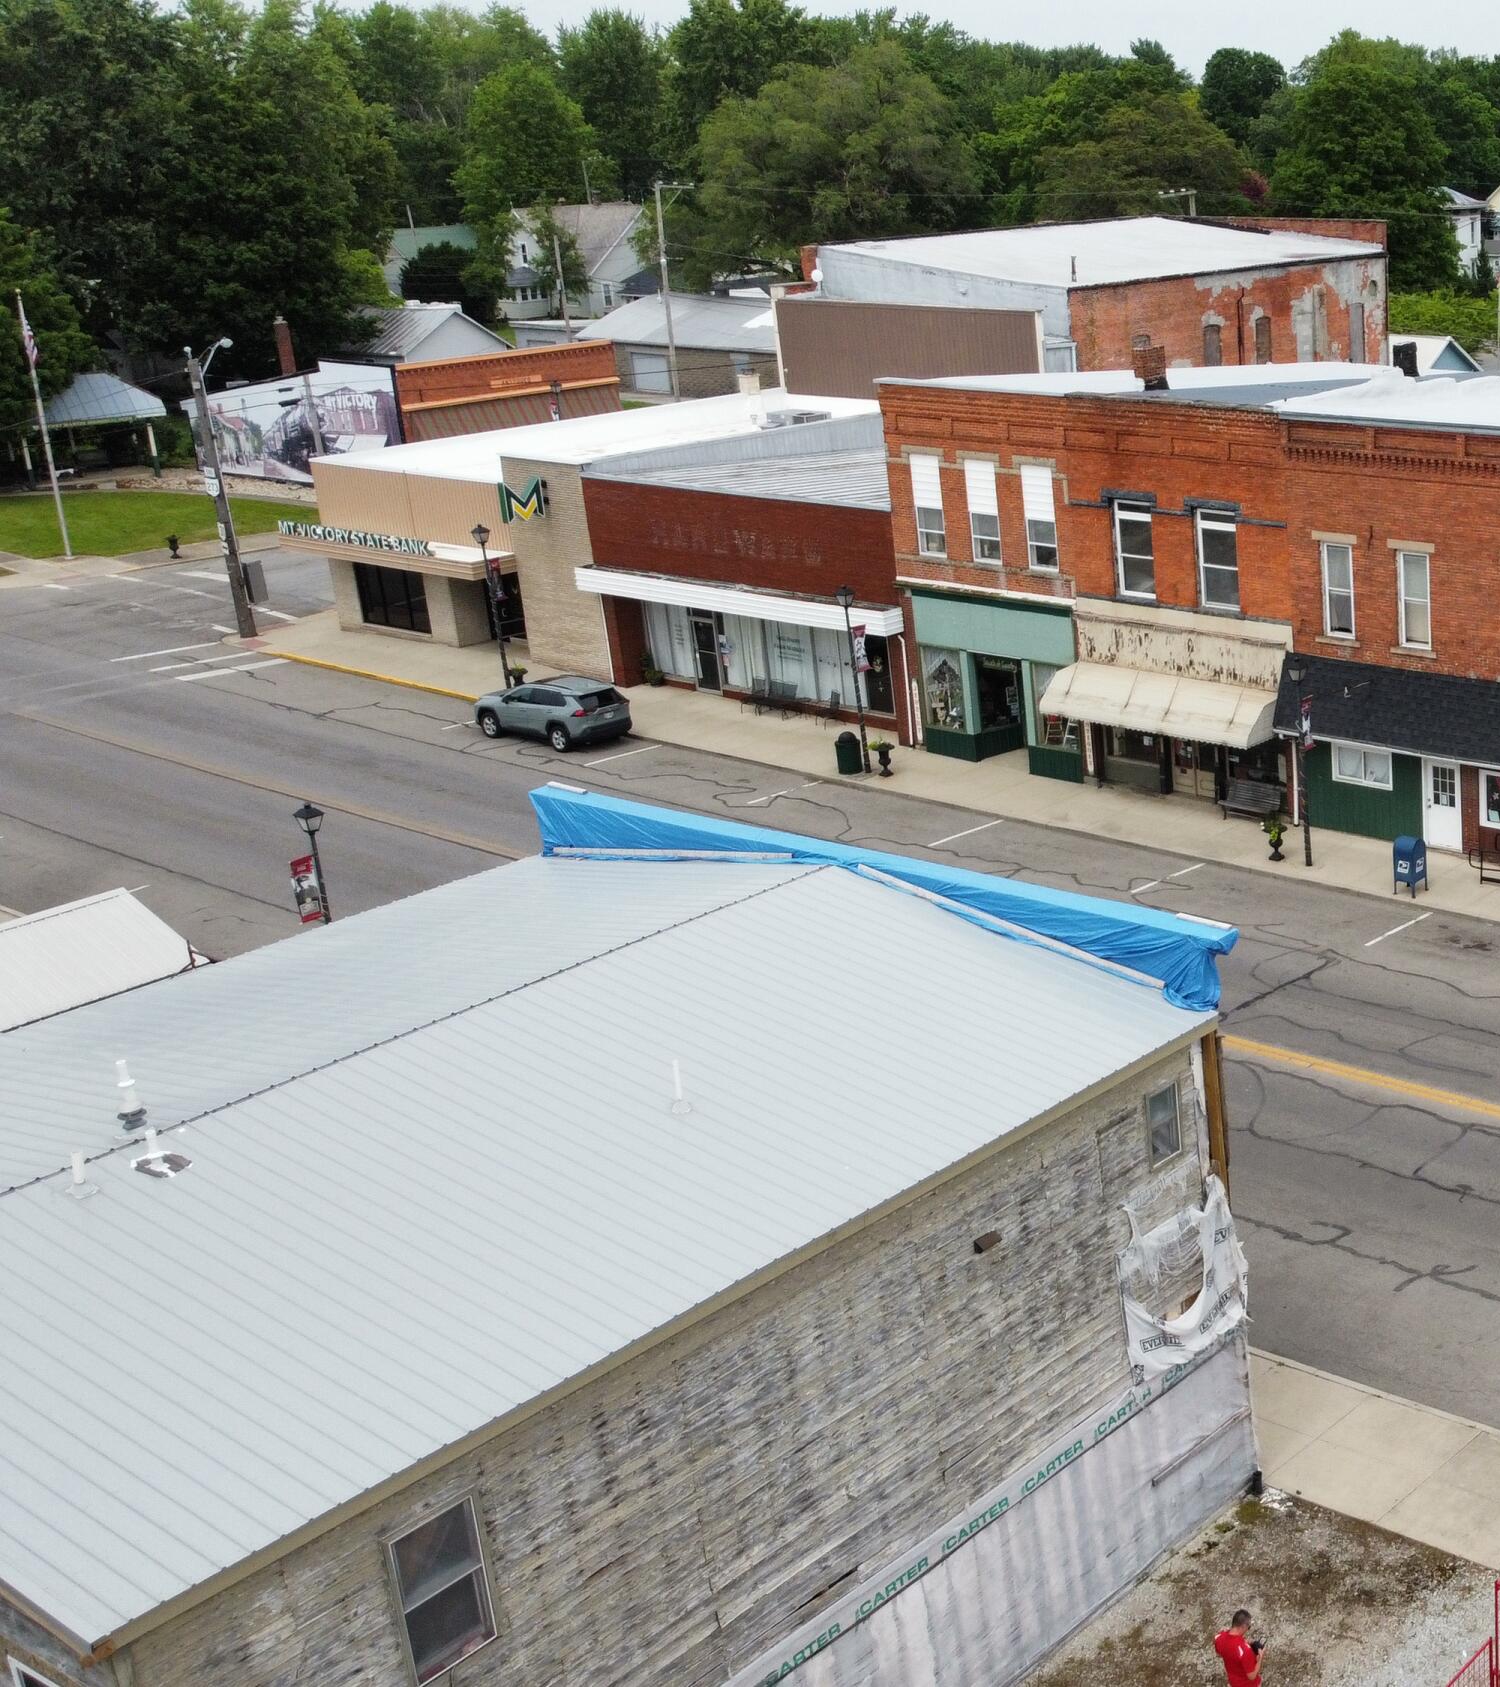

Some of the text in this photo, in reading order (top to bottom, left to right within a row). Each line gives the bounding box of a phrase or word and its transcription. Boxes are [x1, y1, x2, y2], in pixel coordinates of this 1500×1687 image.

[337, 393, 378, 412] VICTORY
[299, 523, 350, 544] VICTORY
[350, 531, 391, 551] STATE
[391, 536, 430, 557] BANK
[1024, 1439, 1085, 1493] CARTER
[945, 1497, 1010, 1550] CARTER
[859, 1557, 930, 1618] CARTER
